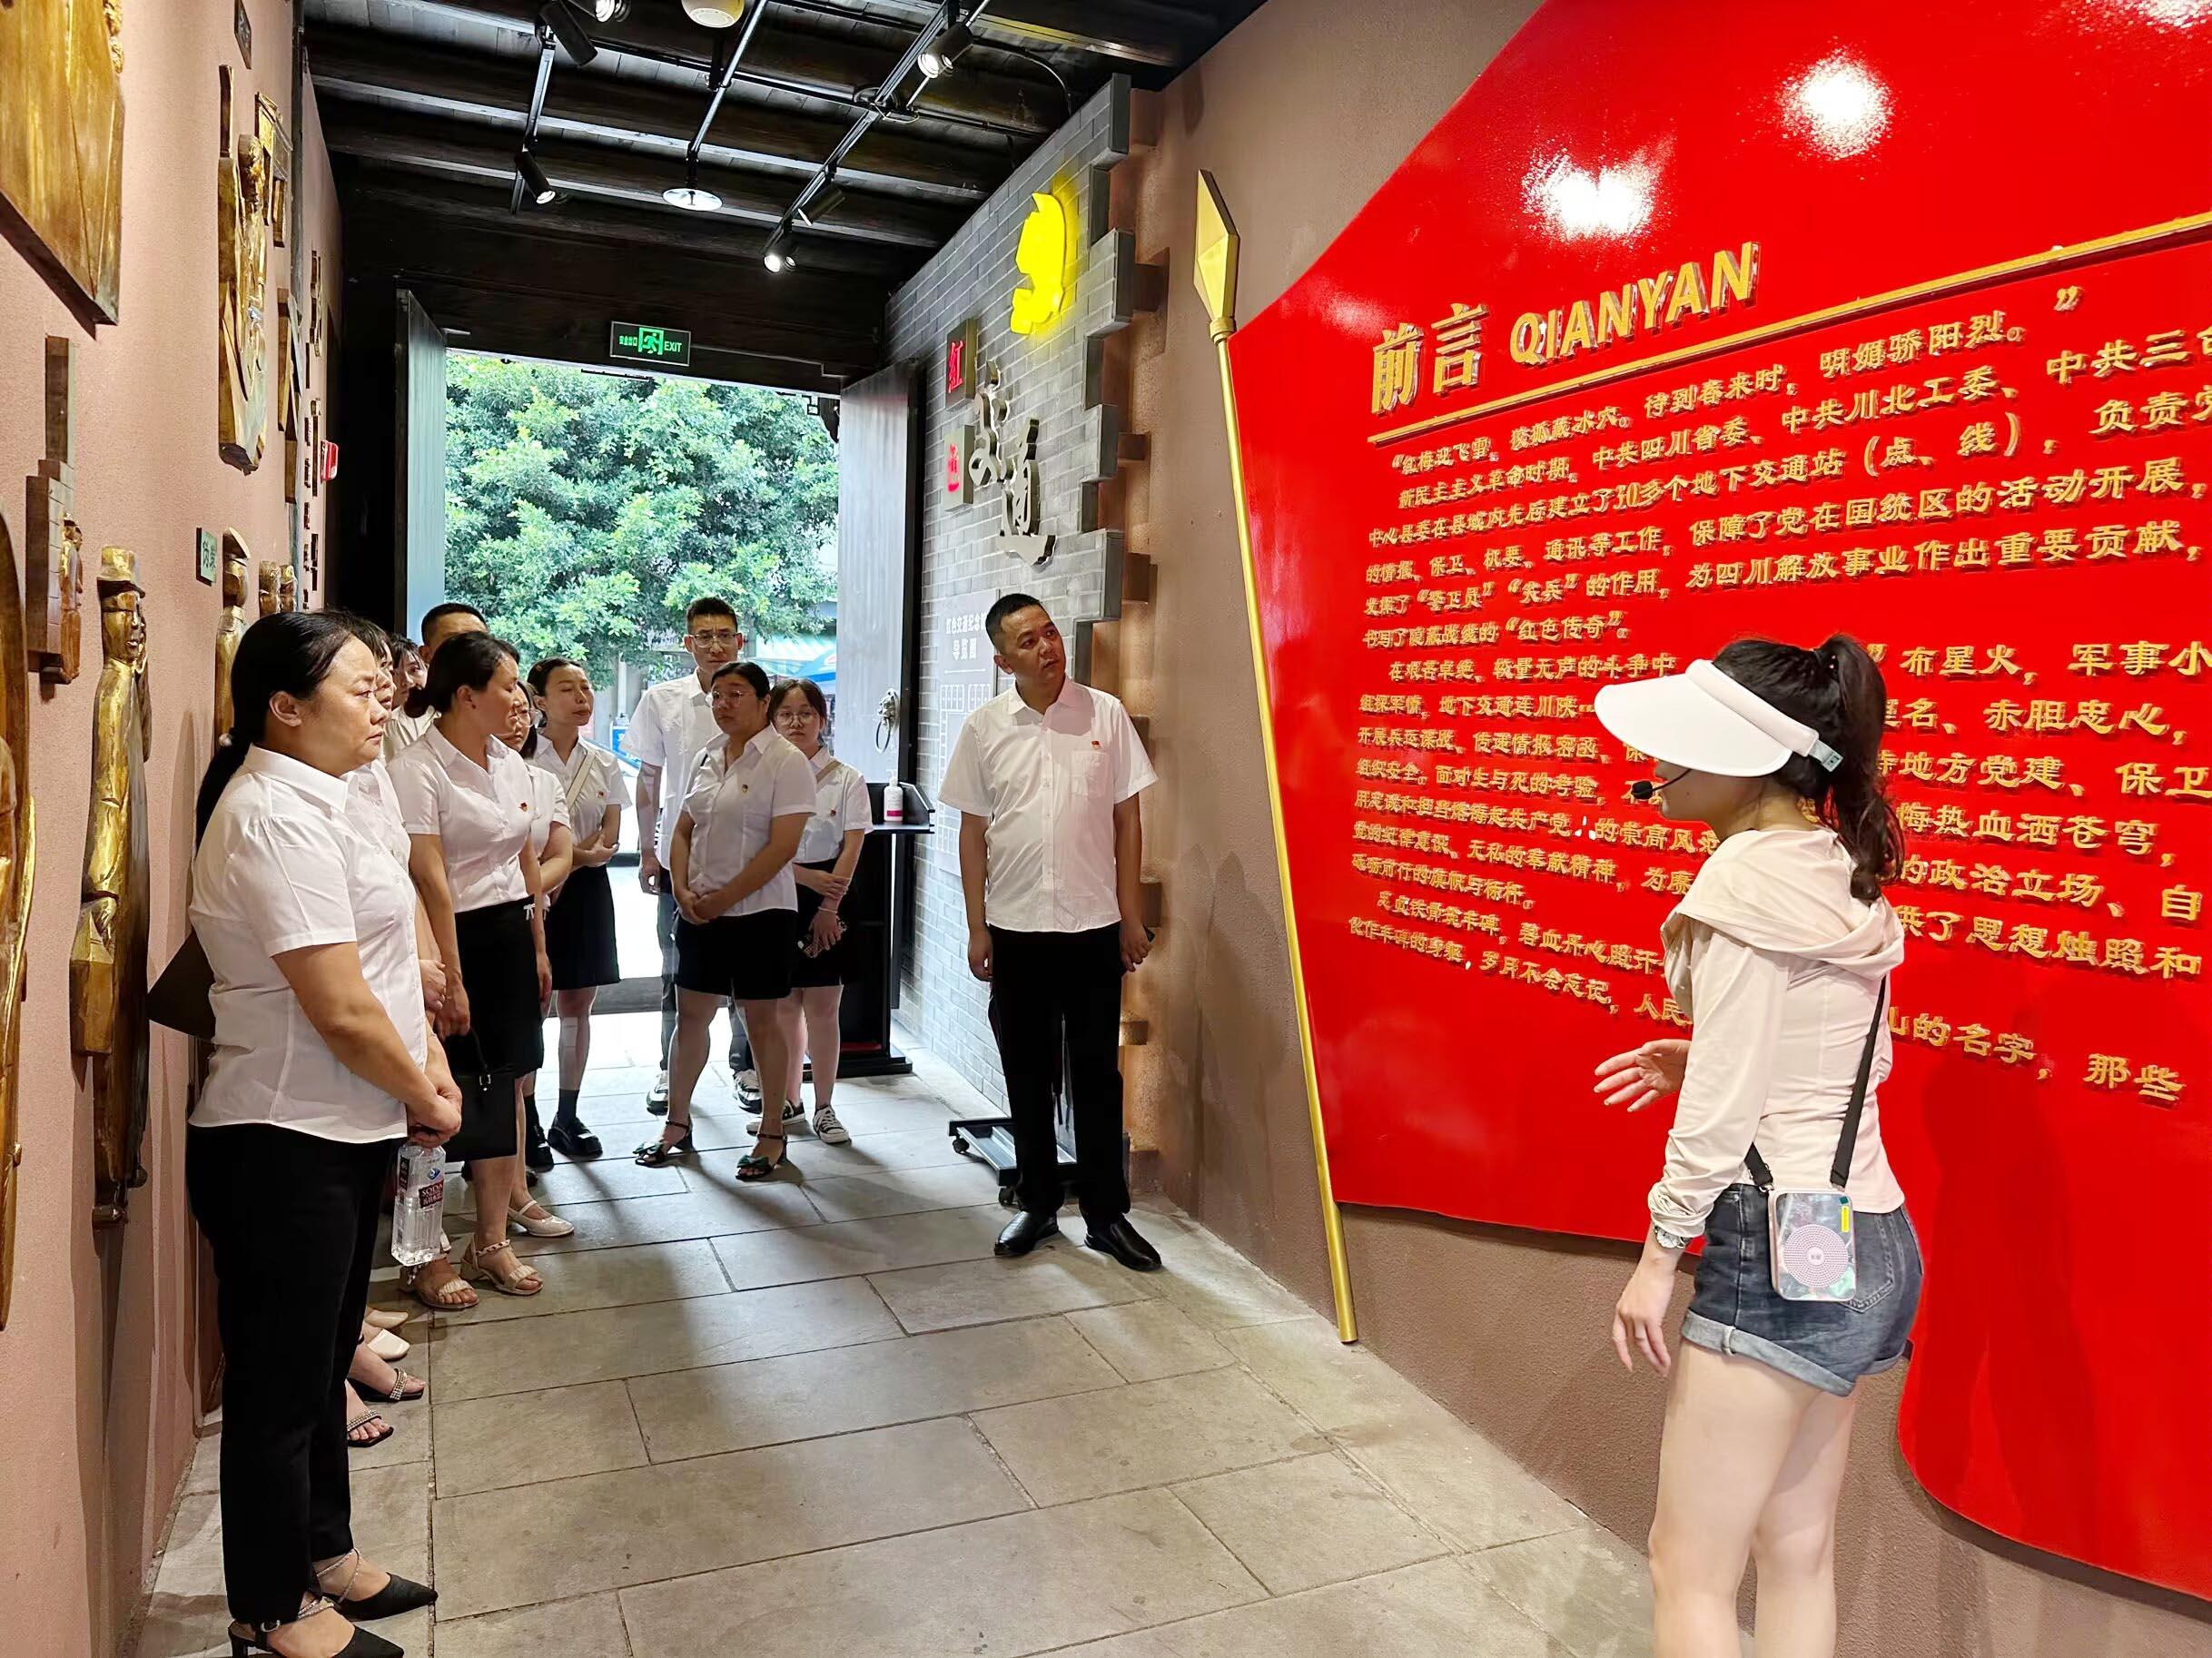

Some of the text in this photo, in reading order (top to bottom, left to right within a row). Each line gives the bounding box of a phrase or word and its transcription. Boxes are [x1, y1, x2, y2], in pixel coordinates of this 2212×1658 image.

[664, 341, 683, 353] EXIT
[1371, 303, 1489, 415] 前言
[1510, 241, 1761, 367] QIANYAN
